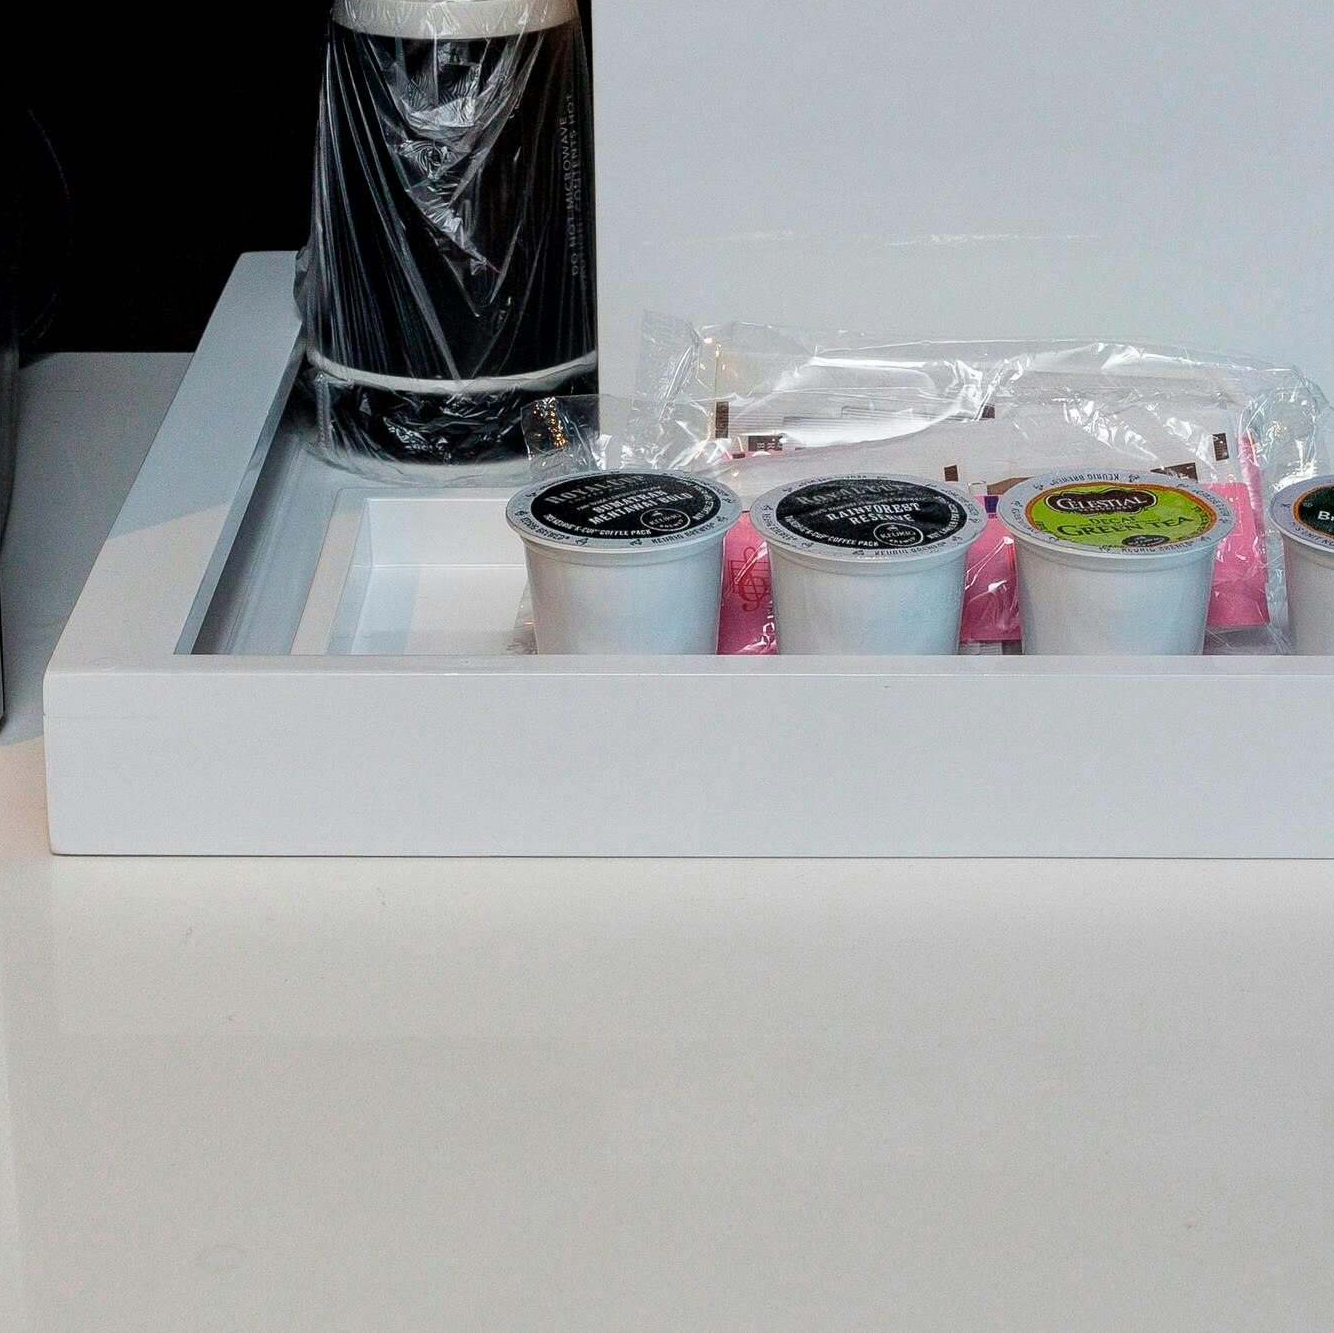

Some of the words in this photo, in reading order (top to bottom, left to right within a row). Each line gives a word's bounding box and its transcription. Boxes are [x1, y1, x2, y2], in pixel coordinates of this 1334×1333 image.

[559, 116, 574, 210] MICROWAVE
[1056, 496, 1148, 509] CELESTIAL
[826, 502, 922, 521] RAINFOREST
[849, 513, 915, 525] RESERVE
[1089, 516, 1137, 524] DECAF
[630, 528, 652, 536] PACK
[1057, 523, 1144, 536] GREEN
[1151, 516, 1194, 528] TEA
[828, 536, 857, 545] COFFEE
